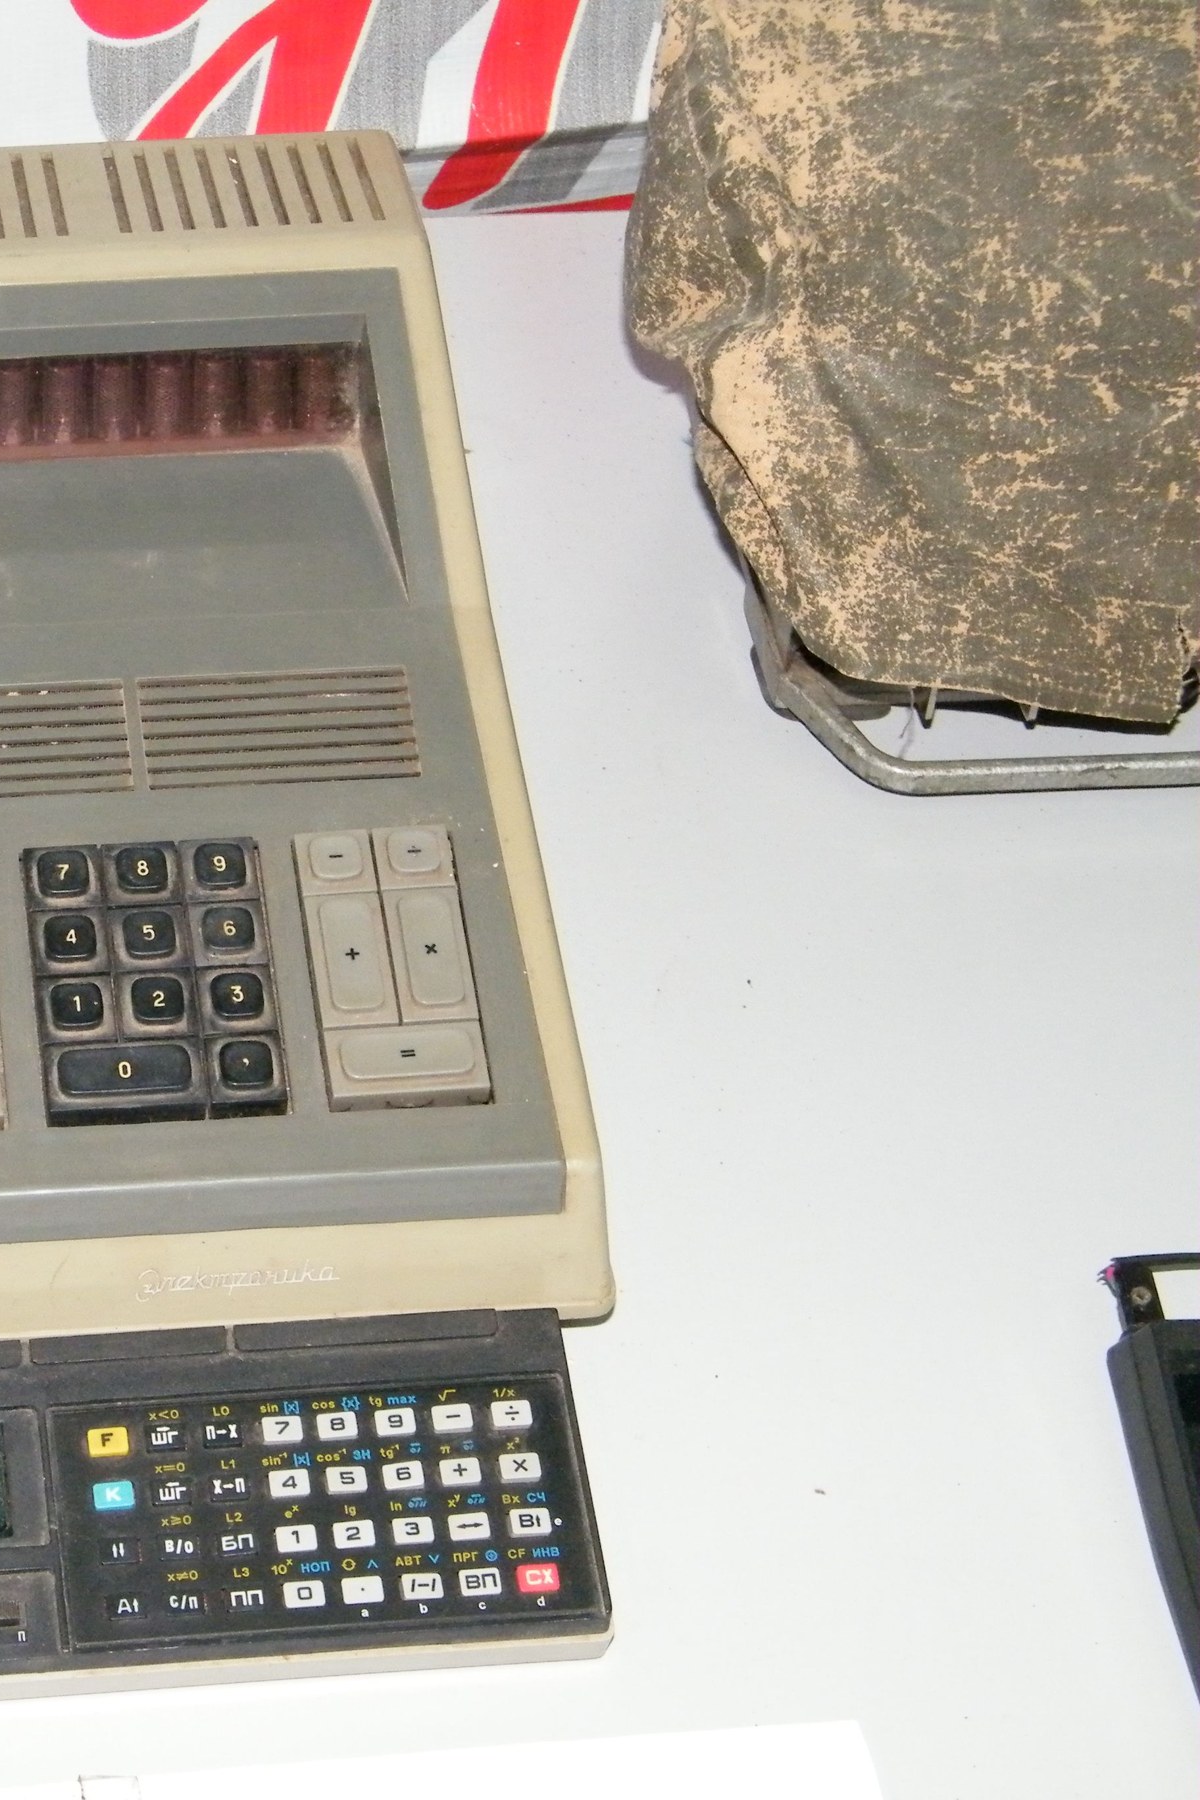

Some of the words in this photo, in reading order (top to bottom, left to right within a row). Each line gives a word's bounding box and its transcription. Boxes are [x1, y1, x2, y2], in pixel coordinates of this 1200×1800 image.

[137, 860, 149, 877] 8
[214, 855, 226, 873] 9
[58, 863, 69, 880] 7
[143, 925, 155, 942] 5
[224, 919, 236, 936] 6
[66, 928, 77, 945] 4
[153, 990, 165, 1007] 2
[231, 985, 243, 1002] 3
[73, 995, 82, 1012] 1
[118, 1061, 131, 1078] 0
[493, 1388, 515, 1398] 1/x
[260, 1402, 279, 1414] sin
[312, 1400, 336, 1410] cos
[369, 1396, 382, 1408] tg
[387, 1395, 417, 1405] max
[275, 1421, 289, 1435] 7
[330, 1417, 346, 1431] 8
[388, 1414, 403, 1428] 9
[101, 1432, 113, 1447] F
[221, 1460, 236, 1469] L1
[340, 1471, 355, 1485] 5
[396, 1466, 411, 1481] 6
[282, 1475, 297, 1489] 4
[344, 1505, 356, 1517] lg
[390, 1501, 402, 1511] ln
[226, 1512, 243, 1523] L2
[345, 1526, 361, 1541] 2
[405, 1521, 420, 1535] 3
[221, 1533, 254, 1551] БП
[291, 1530, 300, 1544] 1
[453, 1552, 478, 1562] ПРГ
[533, 1547, 560, 1558] ИНВ
[300, 1561, 330, 1573] НОП
[395, 1556, 421, 1567] АВТ
[233, 1568, 250, 1578] L3
[466, 1573, 497, 1589] ВП
[230, 1590, 264, 1606] ПП
[297, 1586, 312, 1600] 0
[419, 1603, 428, 1614] b
[478, 1602, 487, 1610] c
[537, 1596, 546, 1607] d
[361, 1608, 369, 1617] a
[18, 1631, 27, 1642] П
